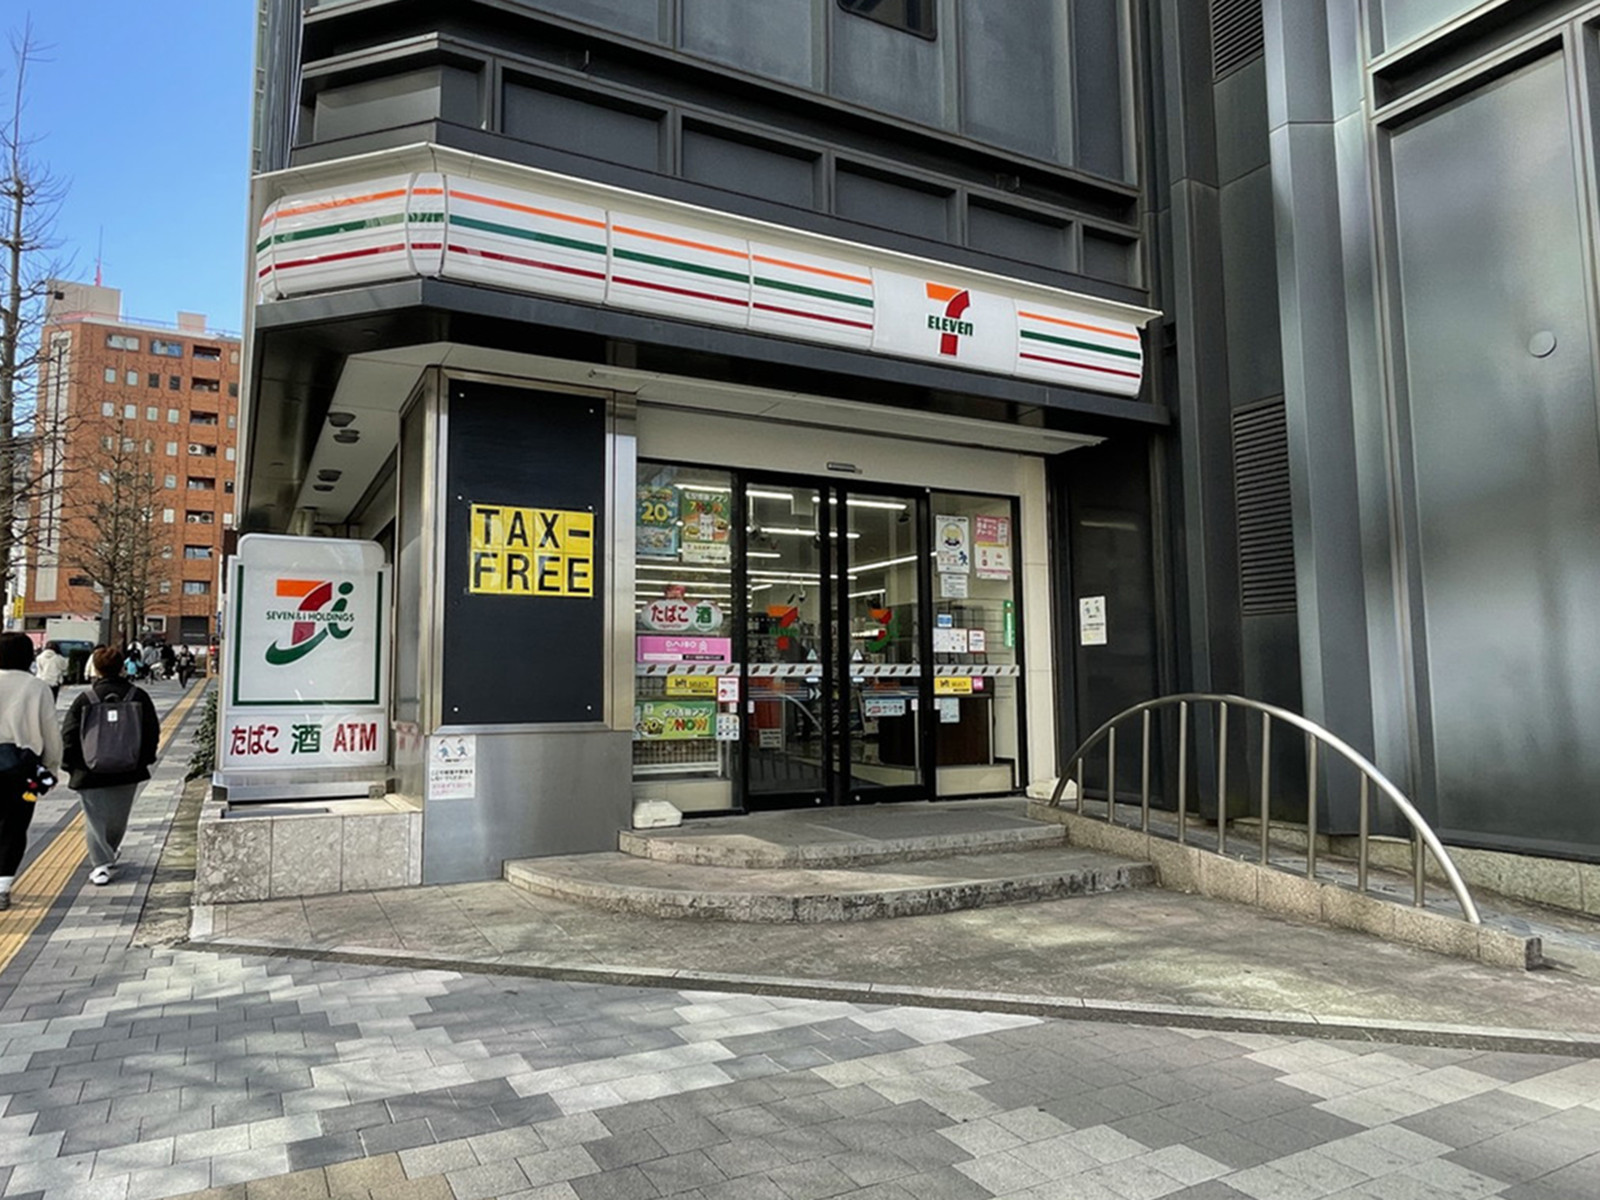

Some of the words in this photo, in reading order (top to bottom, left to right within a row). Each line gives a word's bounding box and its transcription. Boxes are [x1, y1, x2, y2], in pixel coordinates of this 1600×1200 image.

[476, 508, 590, 548] TAX-
[474, 552, 590, 593] FREE
[308, 611, 355, 622] HOLDINGS
[651, 605, 689, 623] たばこ
[696, 606, 712, 623] 酒
[230, 724, 279, 755] たばこ
[291, 724, 322, 754] 酒
[333, 723, 377, 752] ATM
